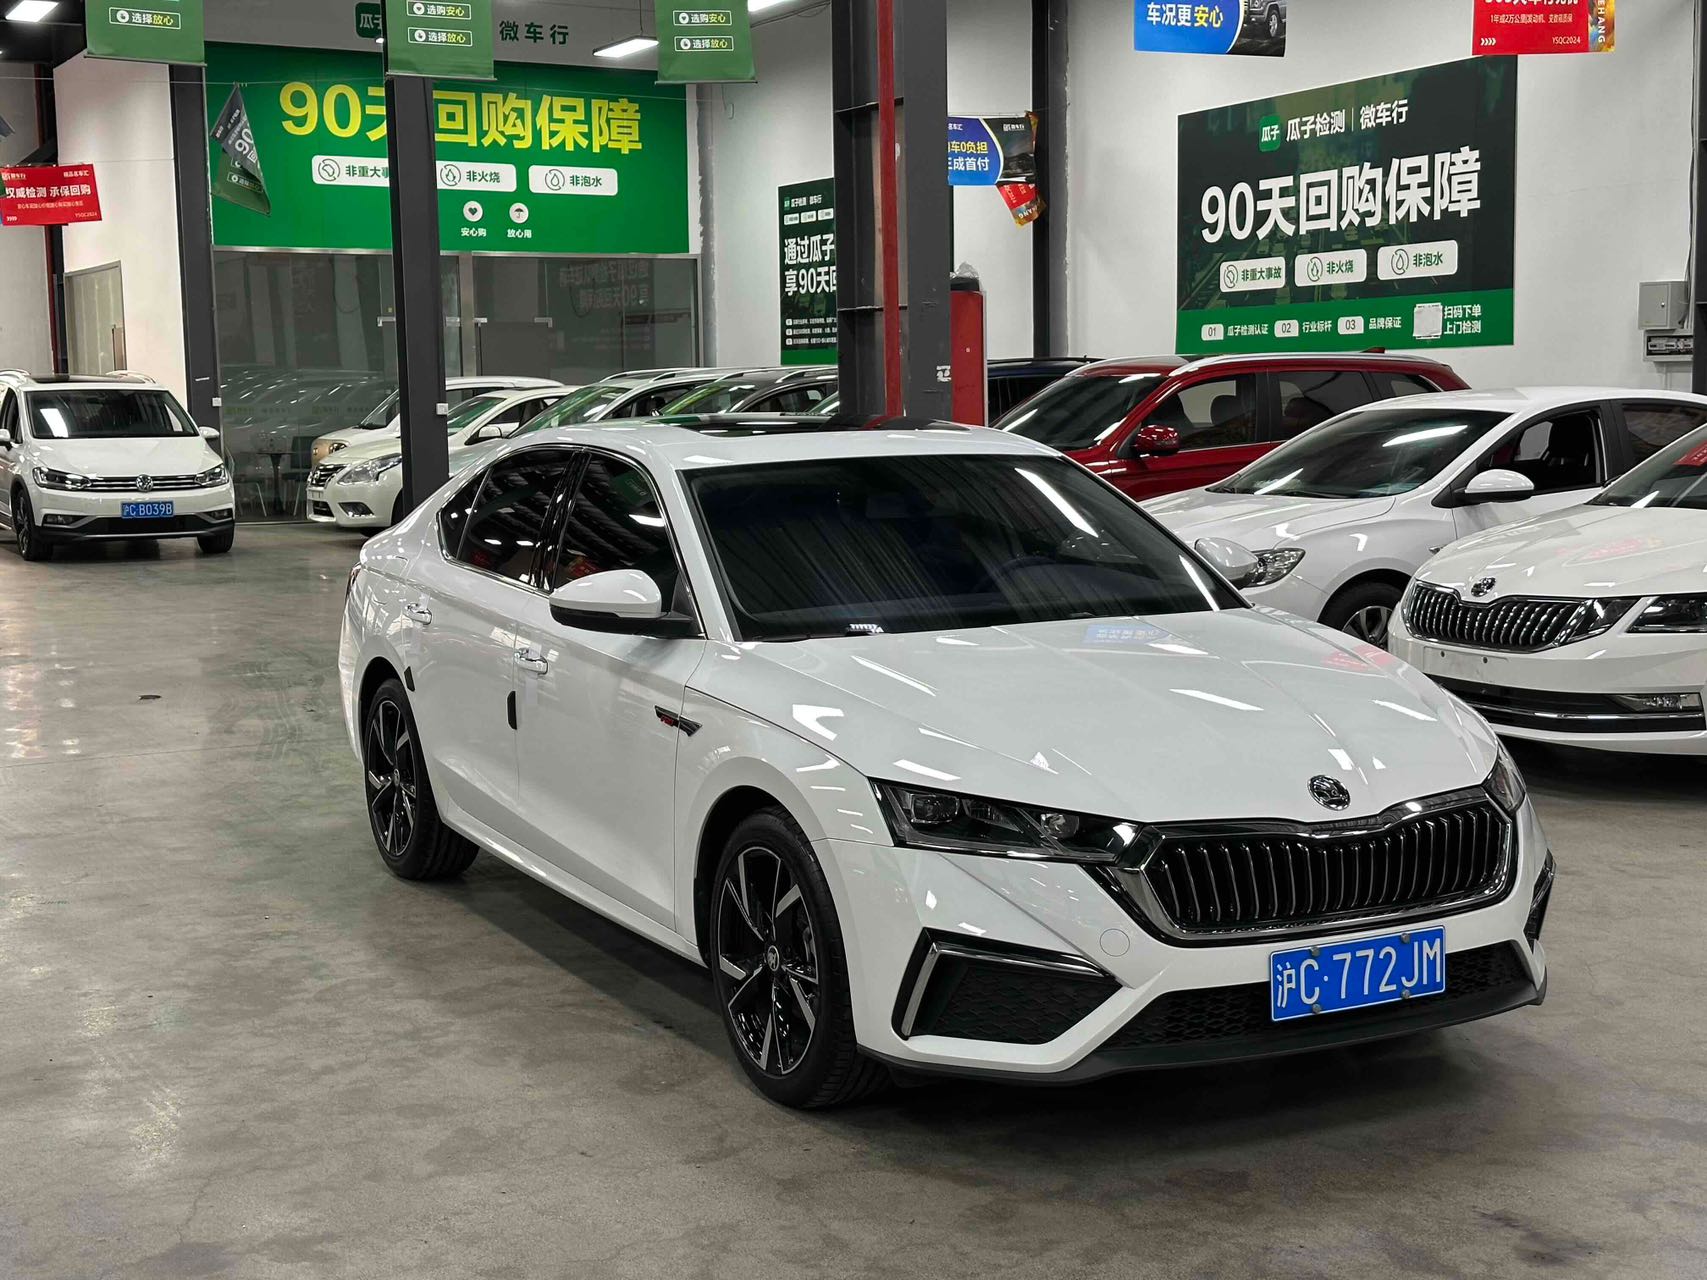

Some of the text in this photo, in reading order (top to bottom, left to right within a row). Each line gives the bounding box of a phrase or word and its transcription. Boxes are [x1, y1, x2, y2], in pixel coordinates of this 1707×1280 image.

[426, 4, 465, 17] 选购安心
[1146, 3, 1224, 28] 车况更安心
[131, 12, 174, 26] 选择放心
[690, 13, 726, 24] 选购安心
[428, 31, 466, 44] 选择放心
[499, 20, 569, 45] 微车行
[692, 38, 728, 49] 选择放心
[1261, 99, 1408, 143] 瓜子 瓜子检测 微车行
[947, 140, 989, 154] 车0负担
[465, 170, 501, 184] 非火烧
[569, 174, 603, 188] 非泡水
[49, 183, 91, 198] 承保回购
[1200, 145, 1481, 243] 90天回购保障
[460, 227, 532, 239] 安心购 放心用
[784, 233, 835, 265] 通过瓜子
[1240, 250, 1443, 282] 非重大事故 非火烧 非泡水
[1444, 304, 1482, 319] 扫码下单
[1207, 316, 1402, 337] 01 瓜子检测认证 02 行业标杆 03 品牌保证
[1444, 319, 1482, 335] 上门检测
